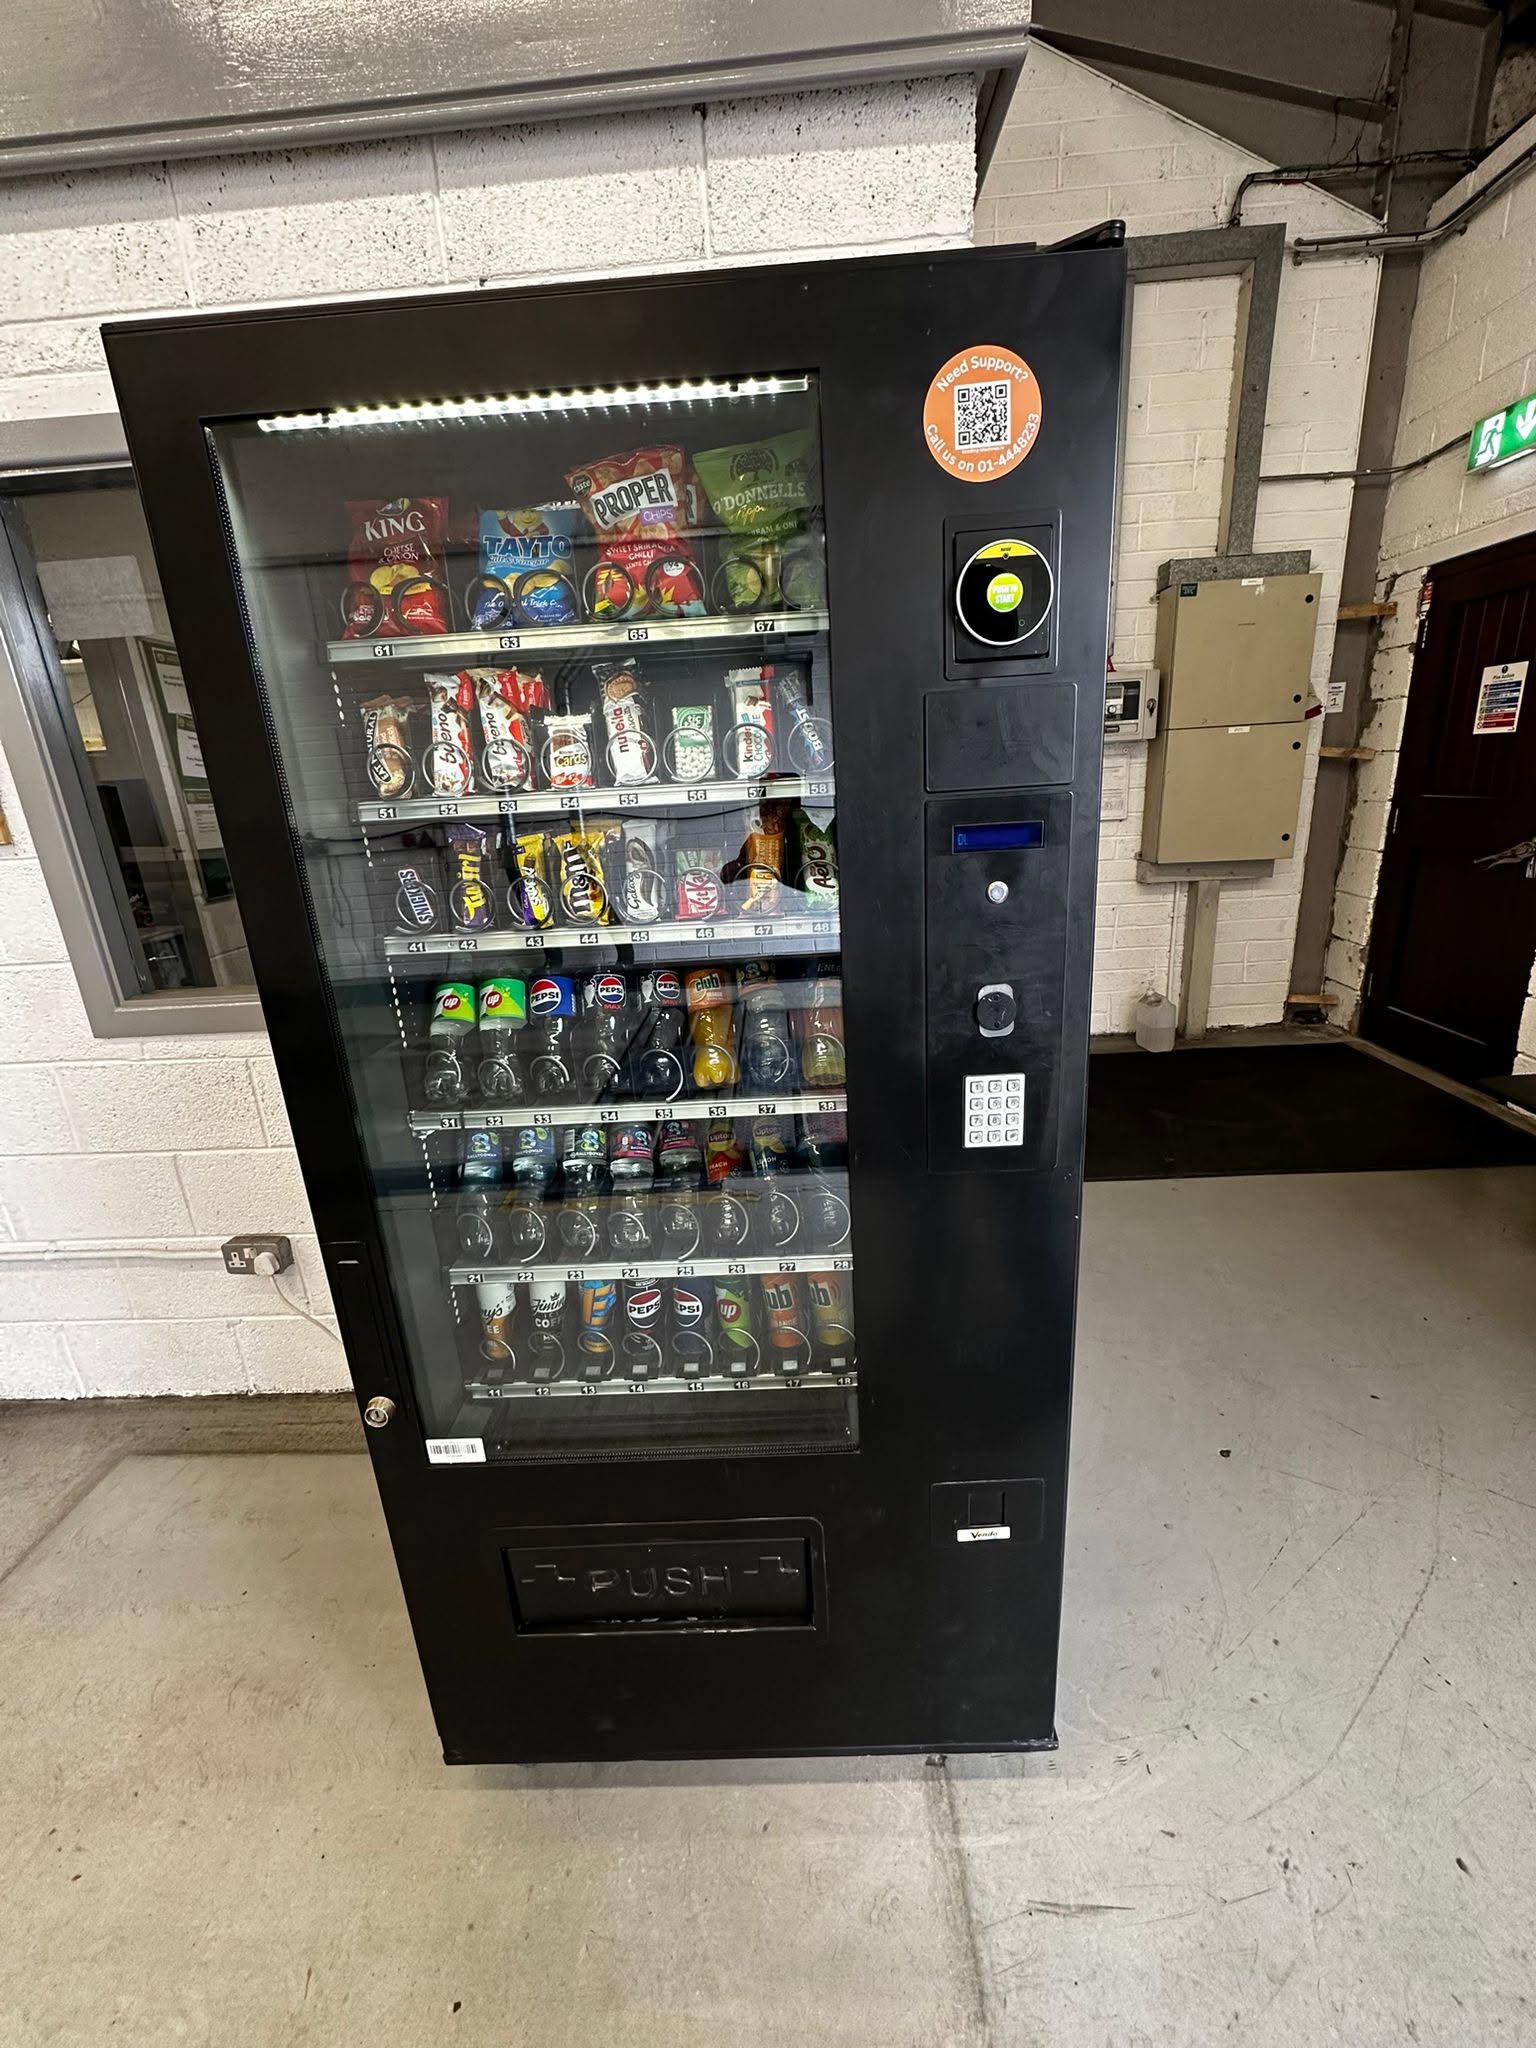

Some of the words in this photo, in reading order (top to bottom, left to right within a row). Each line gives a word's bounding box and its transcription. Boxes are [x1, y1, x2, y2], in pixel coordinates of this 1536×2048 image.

[935, 359, 969, 393] Need
[970, 355, 1029, 383] Support?
[926, 424, 946, 454] Call
[942, 450, 957, 465] us
[958, 460, 975, 473] on
[977, 413, 1040, 473] 01-4448233
[593, 473, 674, 526] PROPER
[643, 509, 674, 522] CHIPS
[364, 511, 426, 542] KING
[383, 543, 414, 557] CHEESE
[483, 534, 574, 559] TAYTO
[606, 545, 631, 556] SWEET
[386, 552, 419, 564] ONION
[628, 550, 654, 560] CHILLI
[756, 621, 773, 632] 67
[629, 628, 647, 640] 65
[501, 637, 518, 648] 63
[374, 645, 391, 656] 61
[796, 708, 824, 752] BOOST
[439, 712, 458, 765] bueno
[743, 727, 754, 763] Kinder
[554, 753, 587, 767] Cards
[374, 765, 390, 781] EAT
[749, 787, 765, 798] 57
[811, 783, 828, 794] 58
[620, 794, 637, 805] 55
[689, 791, 705, 801] 56
[500, 801, 516, 812] 53
[562, 798, 578, 808] 54
[379, 808, 395, 818] 51
[441, 804, 457, 815] 52
[457, 853, 487, 921] Twirl
[626, 872, 641, 910] Galaxy
[399, 869, 432, 924] SNICKERS
[755, 926, 771, 935] 47
[814, 922, 830, 932] 48
[632, 932, 647, 941] 45
[697, 929, 713, 938] 46
[527, 937, 543, 946] 43
[581, 935, 597, 944] 44
[409, 943, 424, 952] 41
[460, 941, 476, 950] 42
[696, 974, 720, 991] club
[600, 986, 623, 994] PEPSI
[531, 991, 559, 1004] PEPSI
[710, 1107, 725, 1116] 36
[760, 1105, 775, 1114] 37
[820, 1102, 835, 1111] 38
[535, 1114, 550, 1123] 33
[601, 1111, 616, 1121] 34
[657, 1109, 672, 1119] 35
[442, 1119, 456, 1128] 31
[487, 1117, 502, 1126] 32
[755, 1126, 782, 1136] Lipton
[709, 1132, 733, 1142] Lipton
[730, 1265, 745, 1273] 26
[780, 1263, 795, 1271] 27
[835, 1260, 849, 1268] 28
[569, 1271, 583, 1279] 23
[623, 1269, 638, 1277] 24
[678, 1267, 693, 1275] 25
[518, 1272, 533, 1281] 22
[736, 1381, 748, 1389] 16
[787, 1379, 799, 1387] 17
[489, 1389, 502, 1397] 11
[537, 1387, 550, 1395] 12
[583, 1386, 595, 1394] 13
[971, 1531, 998, 1539] Vendo
[587, 1566, 733, 1597] PUSH
